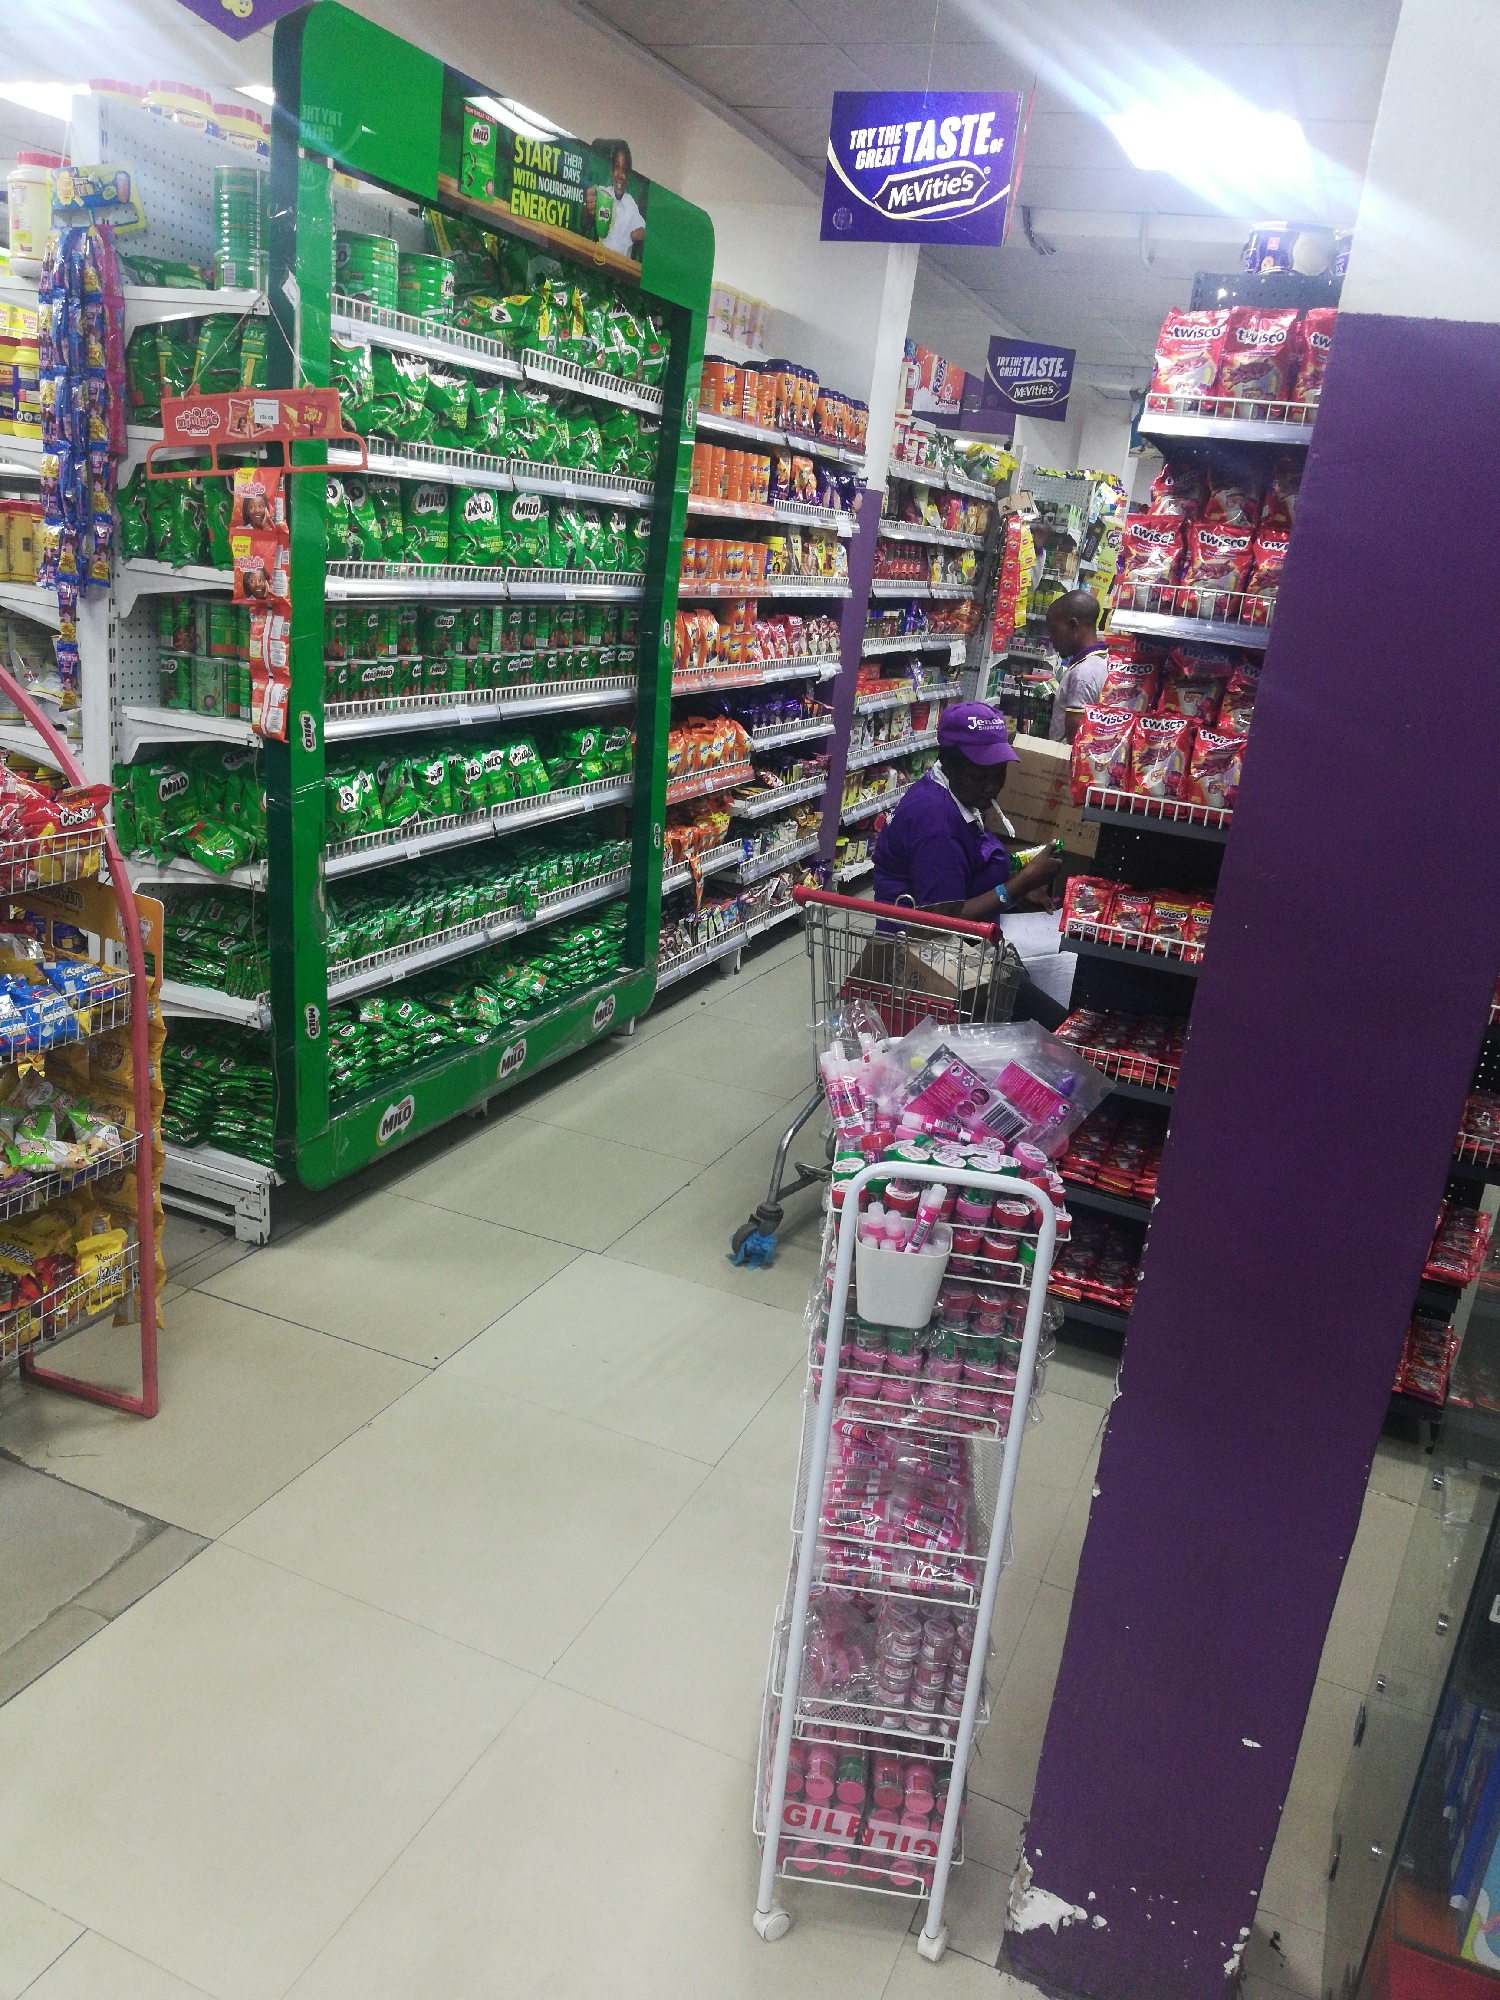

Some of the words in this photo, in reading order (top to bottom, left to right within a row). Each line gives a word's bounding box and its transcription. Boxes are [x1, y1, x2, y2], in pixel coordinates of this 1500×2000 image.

[472, 128, 489, 142] MILO
[850, 127, 878, 150] TRY
[878, 124, 903, 146] THE
[902, 112, 996, 163] TASTE
[989, 138, 1004, 154] OF
[514, 134, 561, 175] START
[563, 150, 583, 171] THEIR
[855, 145, 900, 170] GREAT
[513, 167, 537, 190] WITH
[562, 166, 581, 184] DAYS
[887, 169, 974, 211] McVitie's
[510, 187, 570, 228] ENERGY!
[1173, 326, 1221, 340] twisco
[1237, 329, 1286, 345] twisco
[996, 356, 1010, 367] TRY
[1010, 356, 1023, 367] THE
[1021, 356, 1064, 378] TASTE
[999, 367, 1021, 377] GREAT
[1013, 383, 1054, 399] McVitie's
[418, 493, 446, 508] MILO
[514, 501, 539, 516] MILO
[1132, 525, 1175, 544] twisco
[1200, 531, 1248, 549] twisco
[1089, 711, 1132, 724] twisco
[1142, 718, 1185, 731] twisco
[303, 716, 313, 749] MILO
[161, 778, 188, 798] MILO
[308, 1007, 317, 1036] MILO
[594, 1002, 614, 1025] MILO
[500, 1047, 525, 1074] MILO
[381, 1104, 412, 1137] MILO
